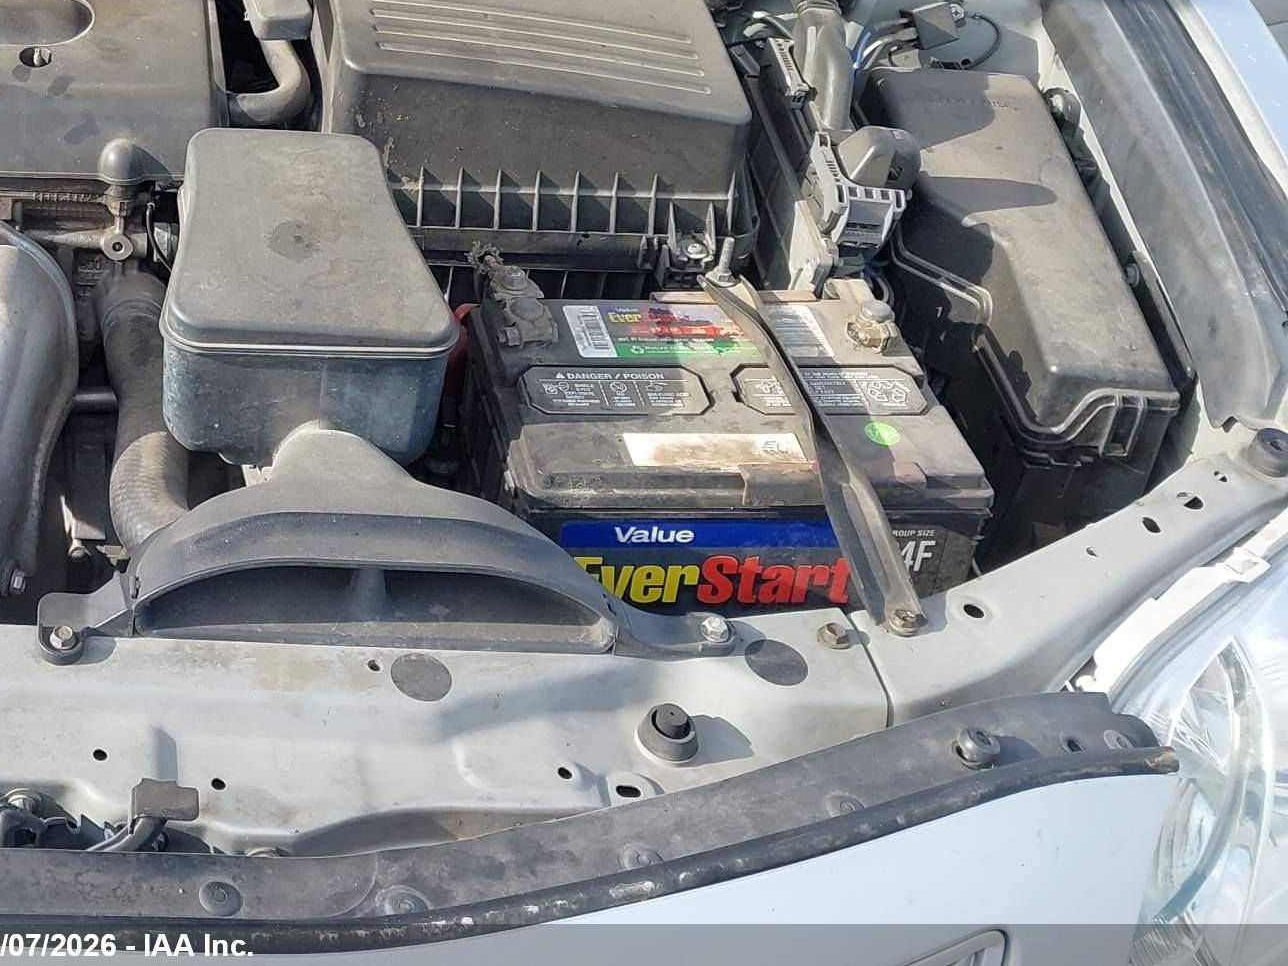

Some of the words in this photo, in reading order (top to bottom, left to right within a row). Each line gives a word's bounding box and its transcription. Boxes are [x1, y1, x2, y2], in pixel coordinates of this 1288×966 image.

[566, 372, 612, 380] DANGER
[614, 526, 695, 544] Value
[892, 529, 917, 537] ROUP
[917, 529, 936, 537] SIZE
[900, 540, 937, 572] 4F
